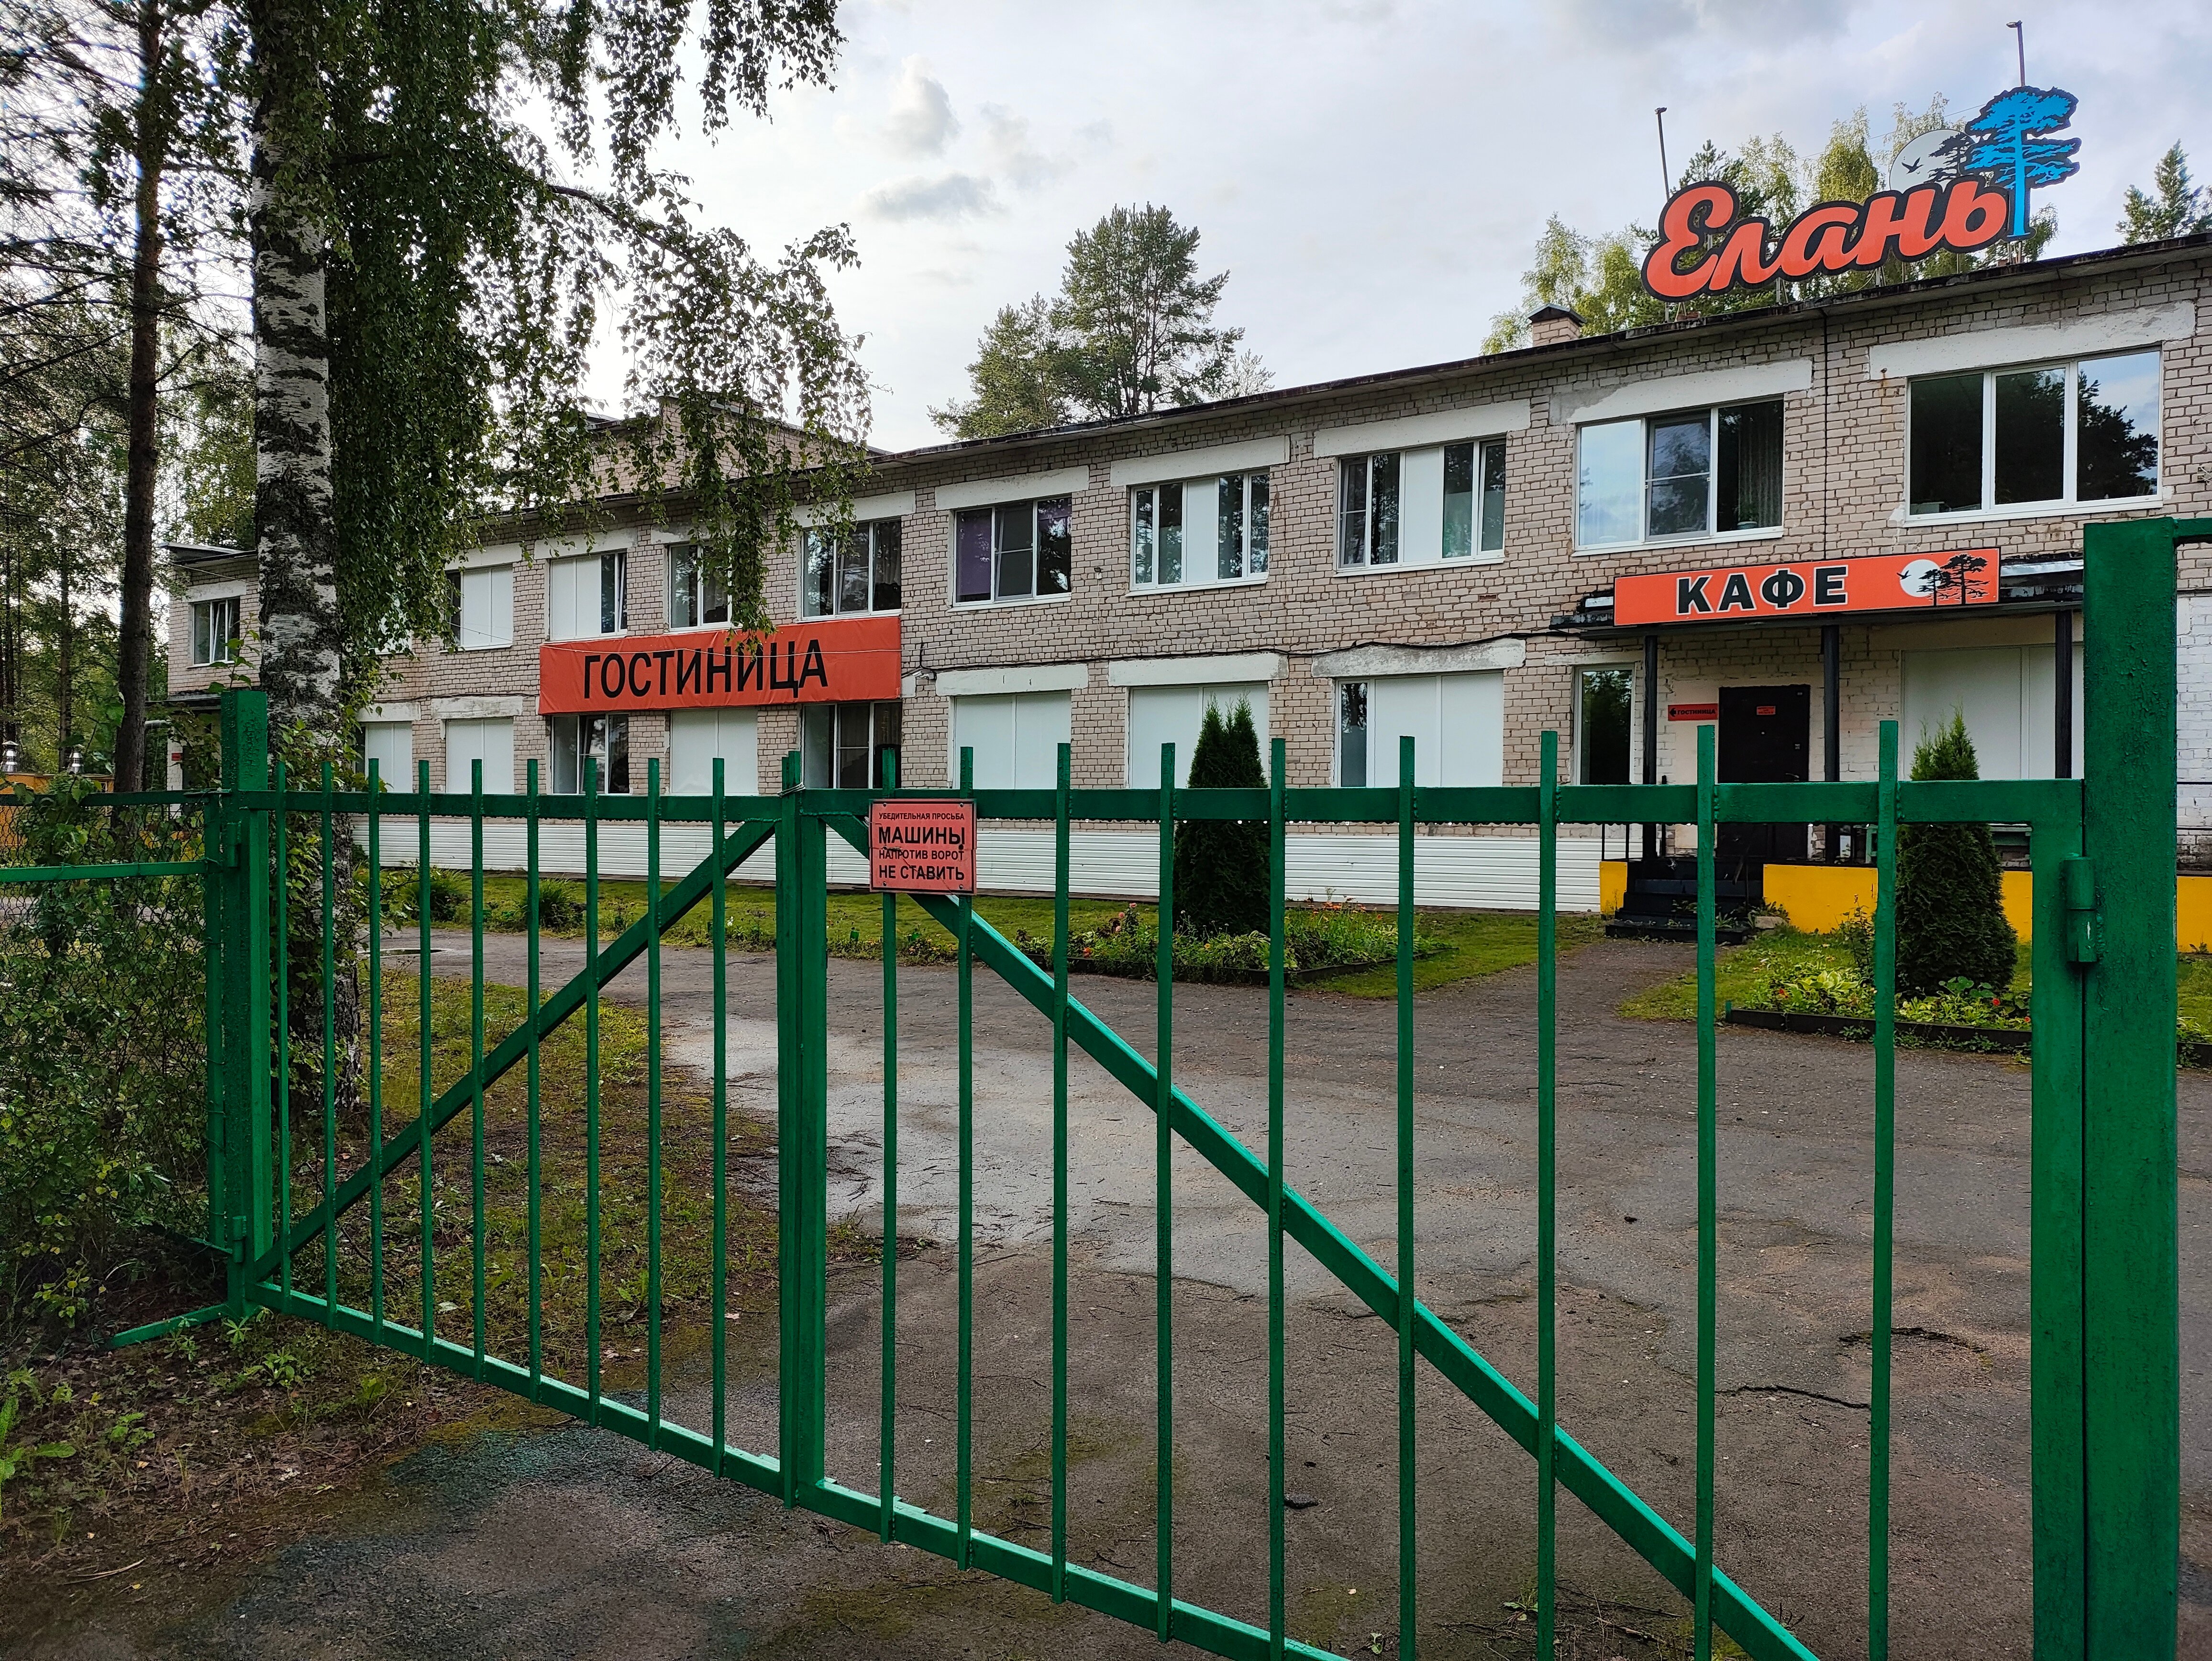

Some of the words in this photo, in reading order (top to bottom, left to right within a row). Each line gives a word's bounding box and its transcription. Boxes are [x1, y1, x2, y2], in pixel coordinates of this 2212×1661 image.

[1643, 177, 2009, 300] Елань
[1677, 565, 1848, 615] КАФЕ
[584, 639, 828, 699] ГОСТИНИЦА
[879, 812, 930, 820] УБЕДИТЕЛЬНАЯ
[878, 826, 965, 844] МАШИНЫ
[879, 850, 928, 860] НАПРОТИВ
[931, 850, 964, 860] ВОРОТ
[879, 864, 896, 879] НЕ
[900, 865, 965, 880] СТАВИТЬ
